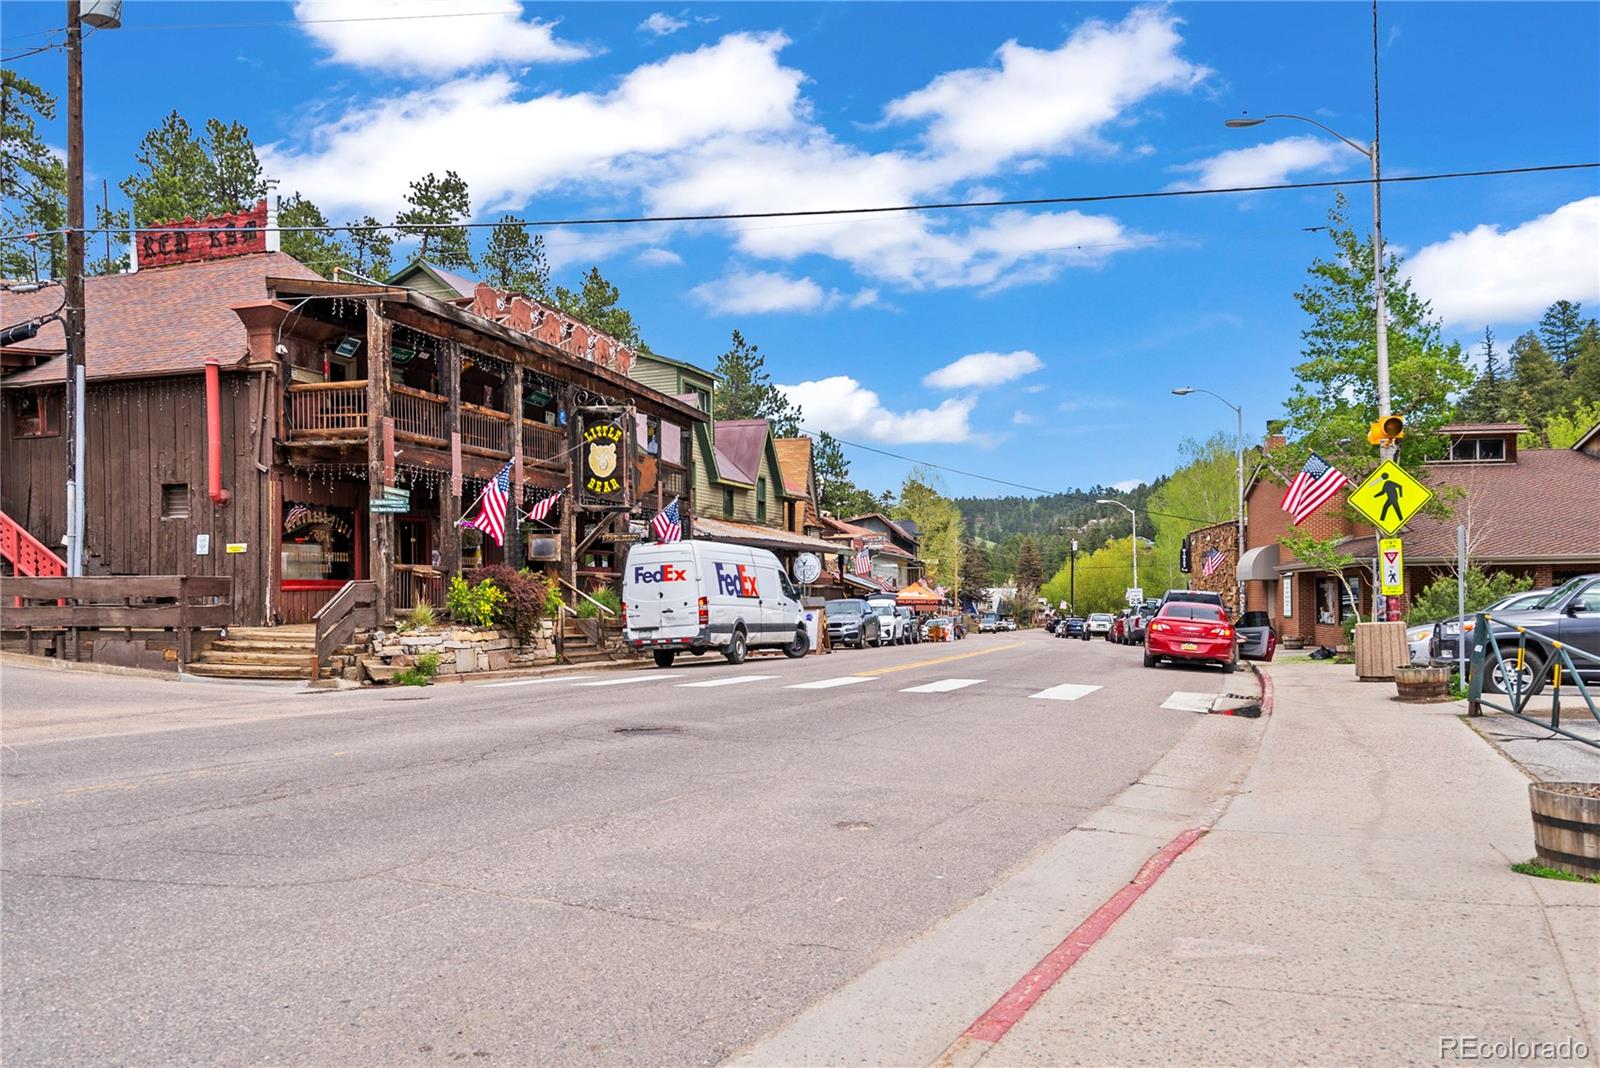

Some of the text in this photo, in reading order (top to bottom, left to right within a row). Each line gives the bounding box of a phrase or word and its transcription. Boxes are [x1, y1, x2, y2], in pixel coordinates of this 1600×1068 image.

[143, 230, 191, 258] RED
[584, 425, 622, 442] LITTLE
[587, 478, 620, 493] BEAR
[635, 564, 687, 584] FedEx
[714, 562, 759, 597] FedEx
